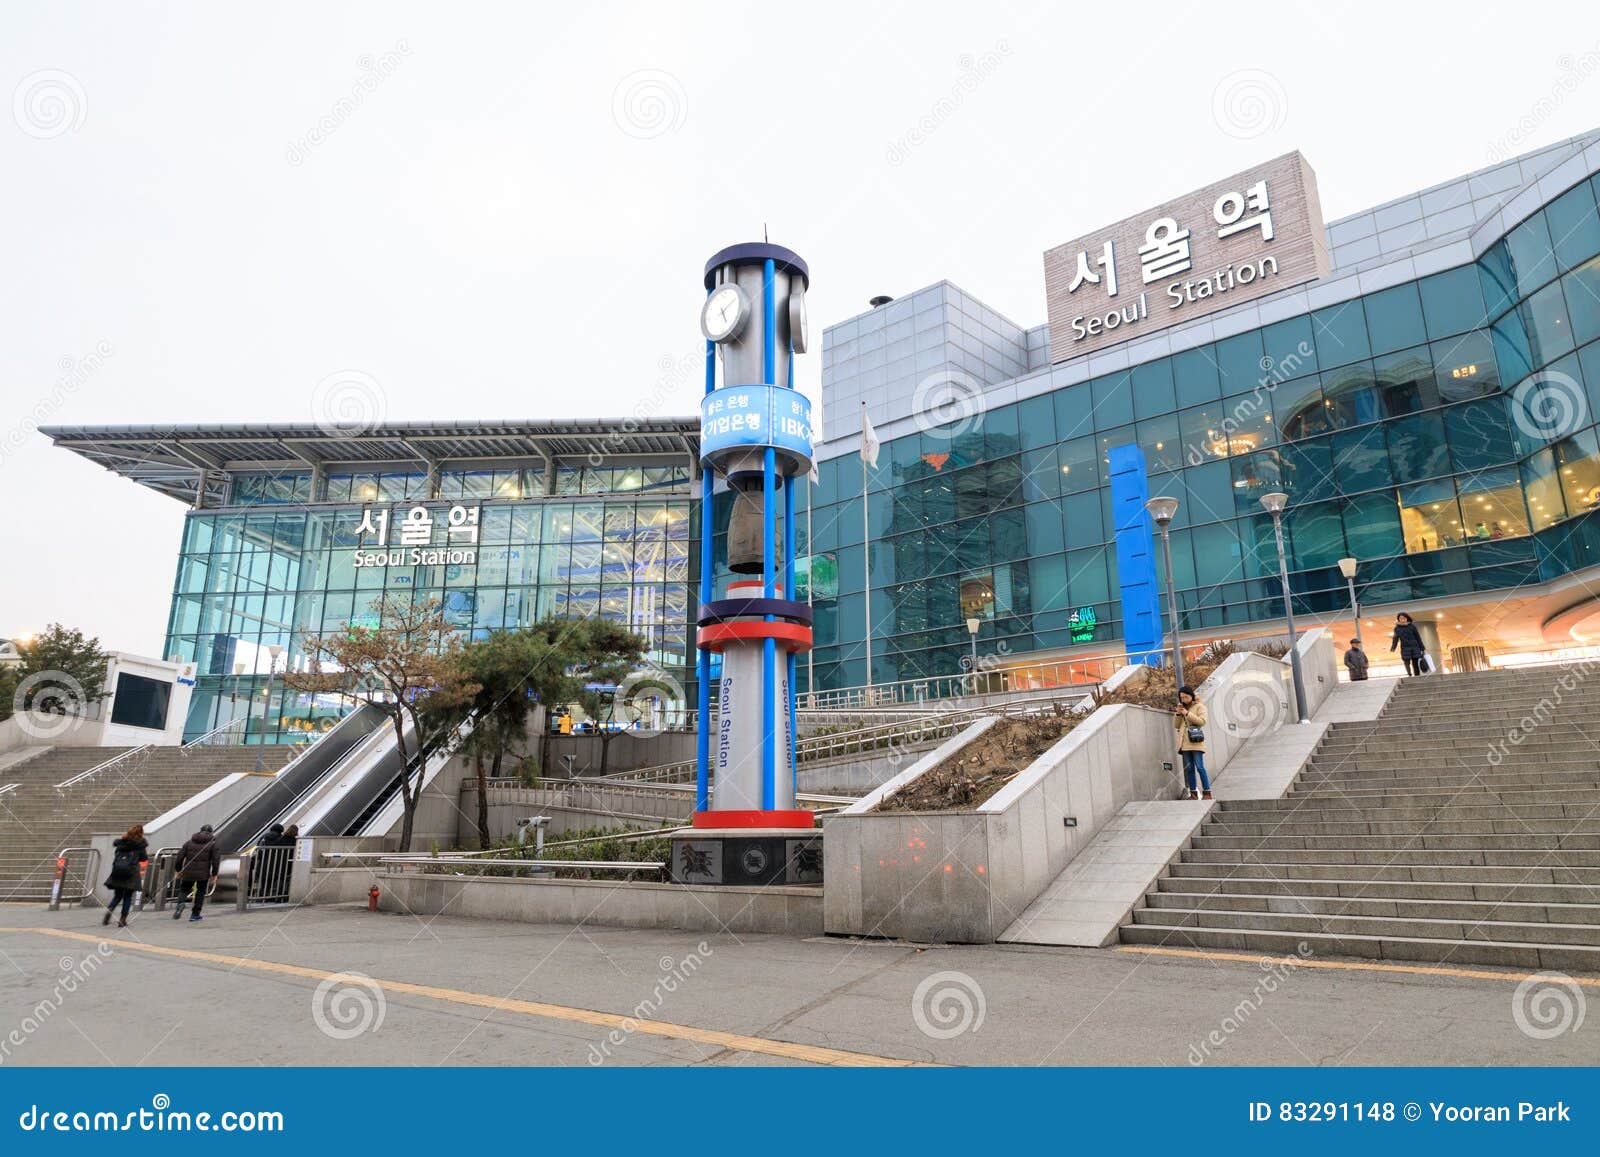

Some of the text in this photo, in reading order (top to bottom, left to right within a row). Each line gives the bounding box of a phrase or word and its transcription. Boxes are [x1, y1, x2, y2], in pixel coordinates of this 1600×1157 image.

[1069, 180, 1274, 297] 서울역
[1072, 256, 1278, 341] Seoul Station
[353, 549, 405, 567] Seoul
[410, 548, 475, 565] Station
[355, 506, 479, 545] 서울역
[719, 678, 732, 767] Seoul Station
